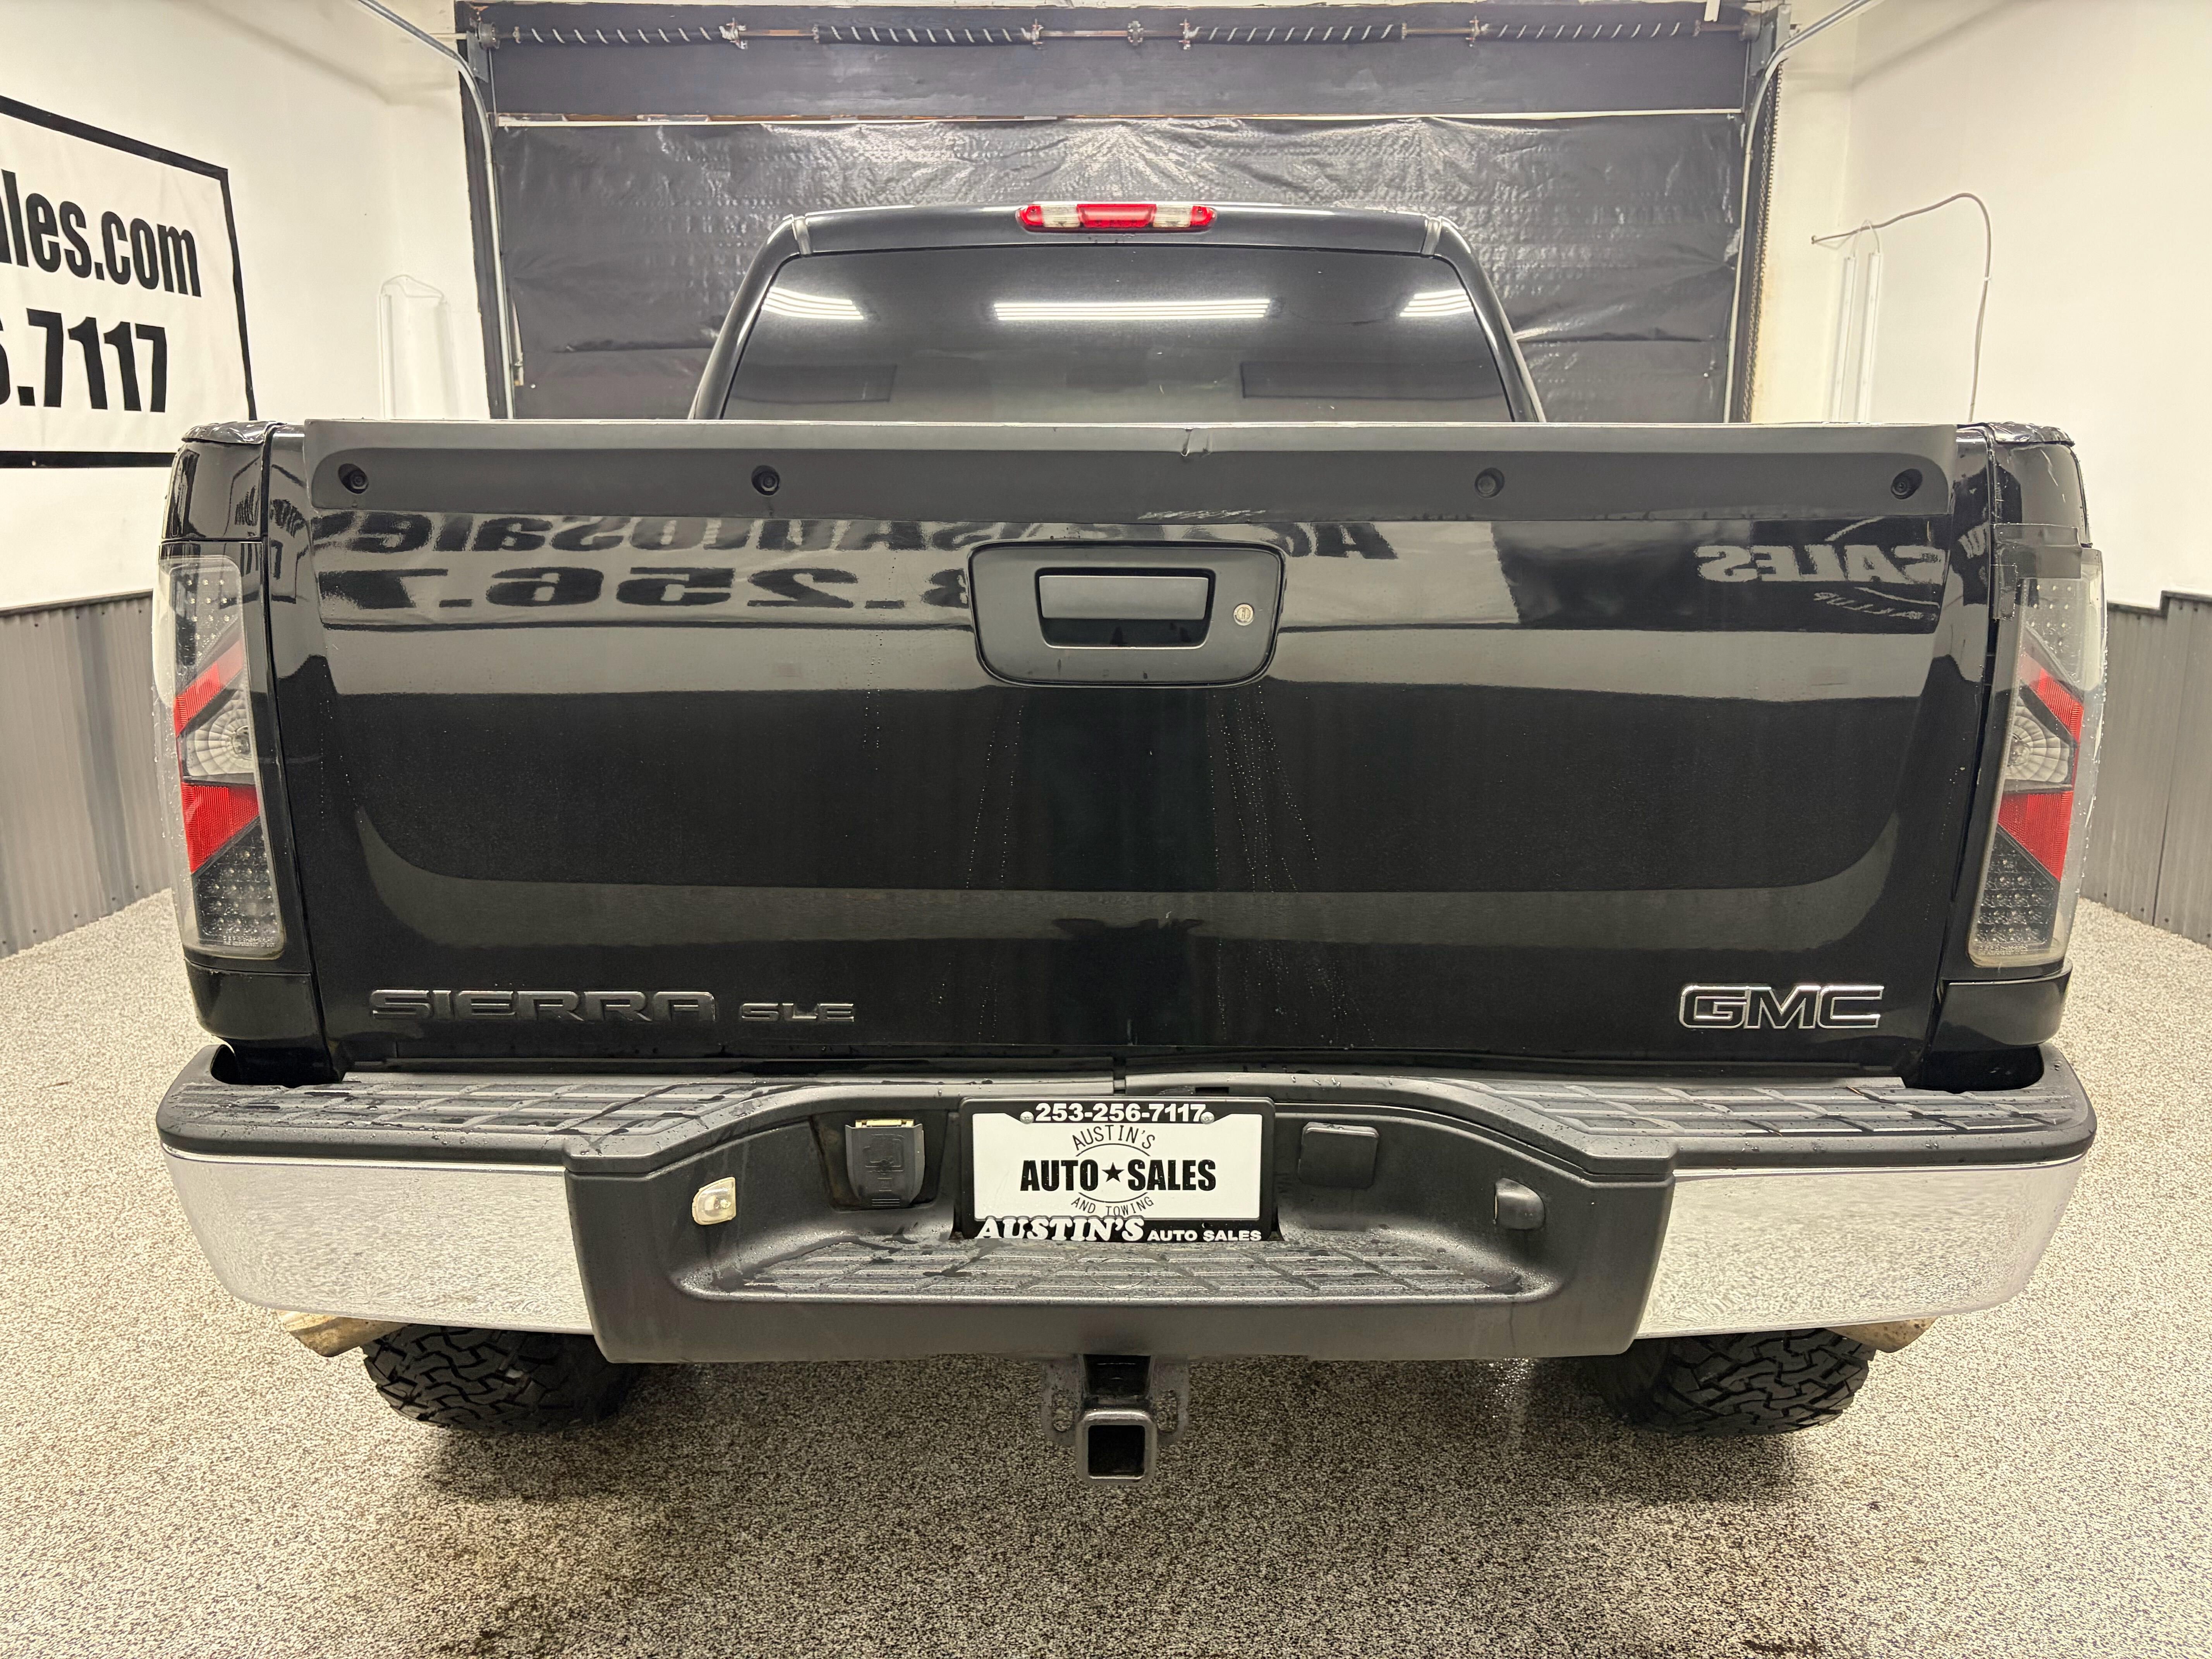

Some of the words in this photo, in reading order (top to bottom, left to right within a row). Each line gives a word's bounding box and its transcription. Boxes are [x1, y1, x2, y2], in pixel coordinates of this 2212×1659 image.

[370, 989, 716, 1022] SIERRA
[739, 1002, 855, 1022] SLE
[1679, 984, 1885, 1029] GMC
[1035, 1103, 1206, 1122] 253-256-7117
[1072, 1124, 1156, 1151] AUSTIN'S
[1020, 1159, 1099, 1191] AUTO
[1127, 1159, 1216, 1191] SALES
[1071, 1197, 1096, 1214] AND
[1105, 1196, 1154, 1216] TOWING
[974, 1217, 1145, 1242] AUSTIN'S
[1147, 1230, 1198, 1242] AUTO
[1202, 1230, 1262, 1242] SALES
